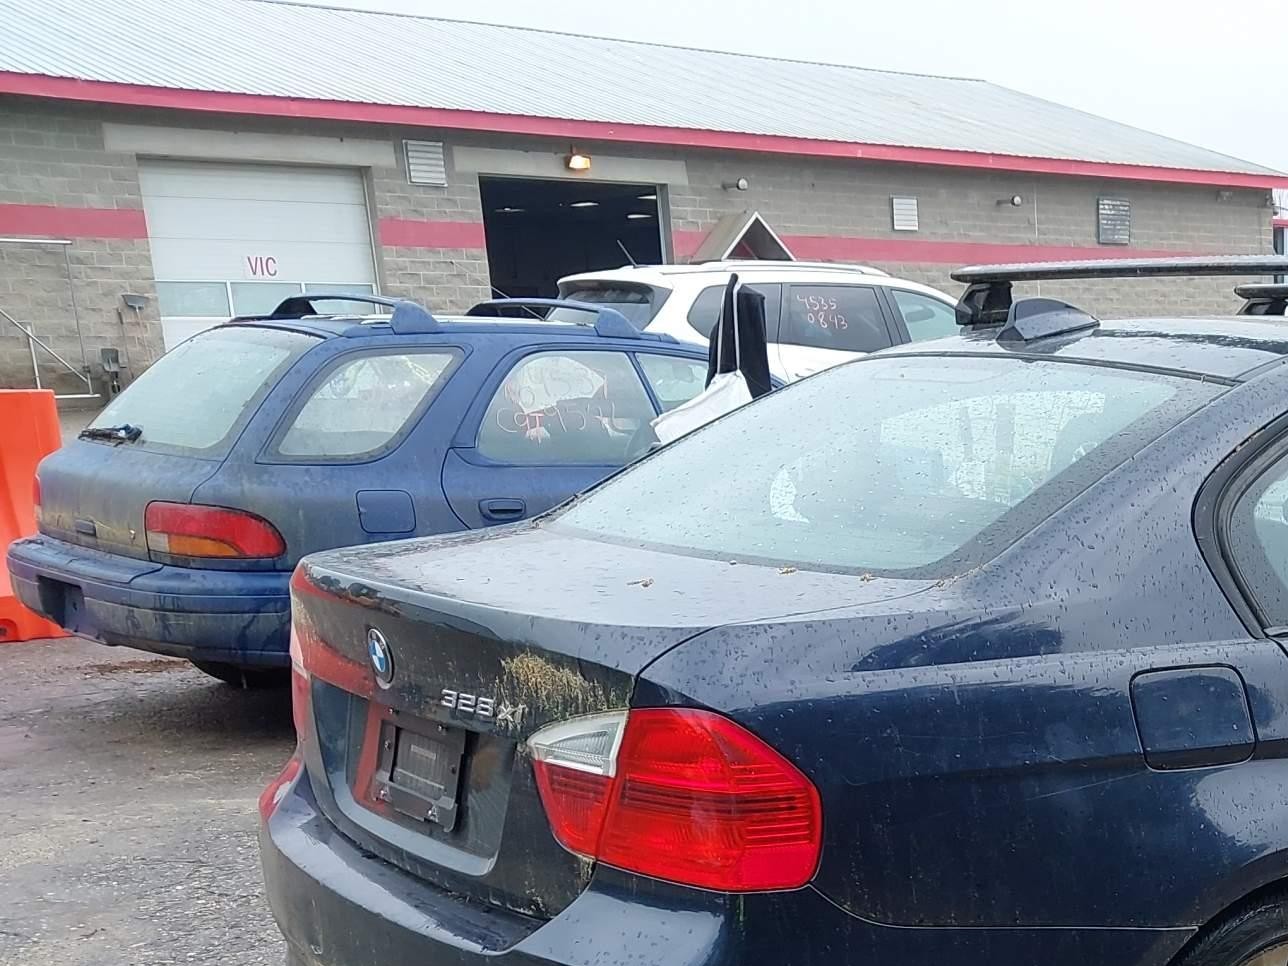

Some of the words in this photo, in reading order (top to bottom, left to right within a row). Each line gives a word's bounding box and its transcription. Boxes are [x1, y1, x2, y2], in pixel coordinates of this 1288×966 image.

[247, 256, 277, 276] VIC
[797, 294, 837, 310] 4535
[807, 312, 848, 329] 0843
